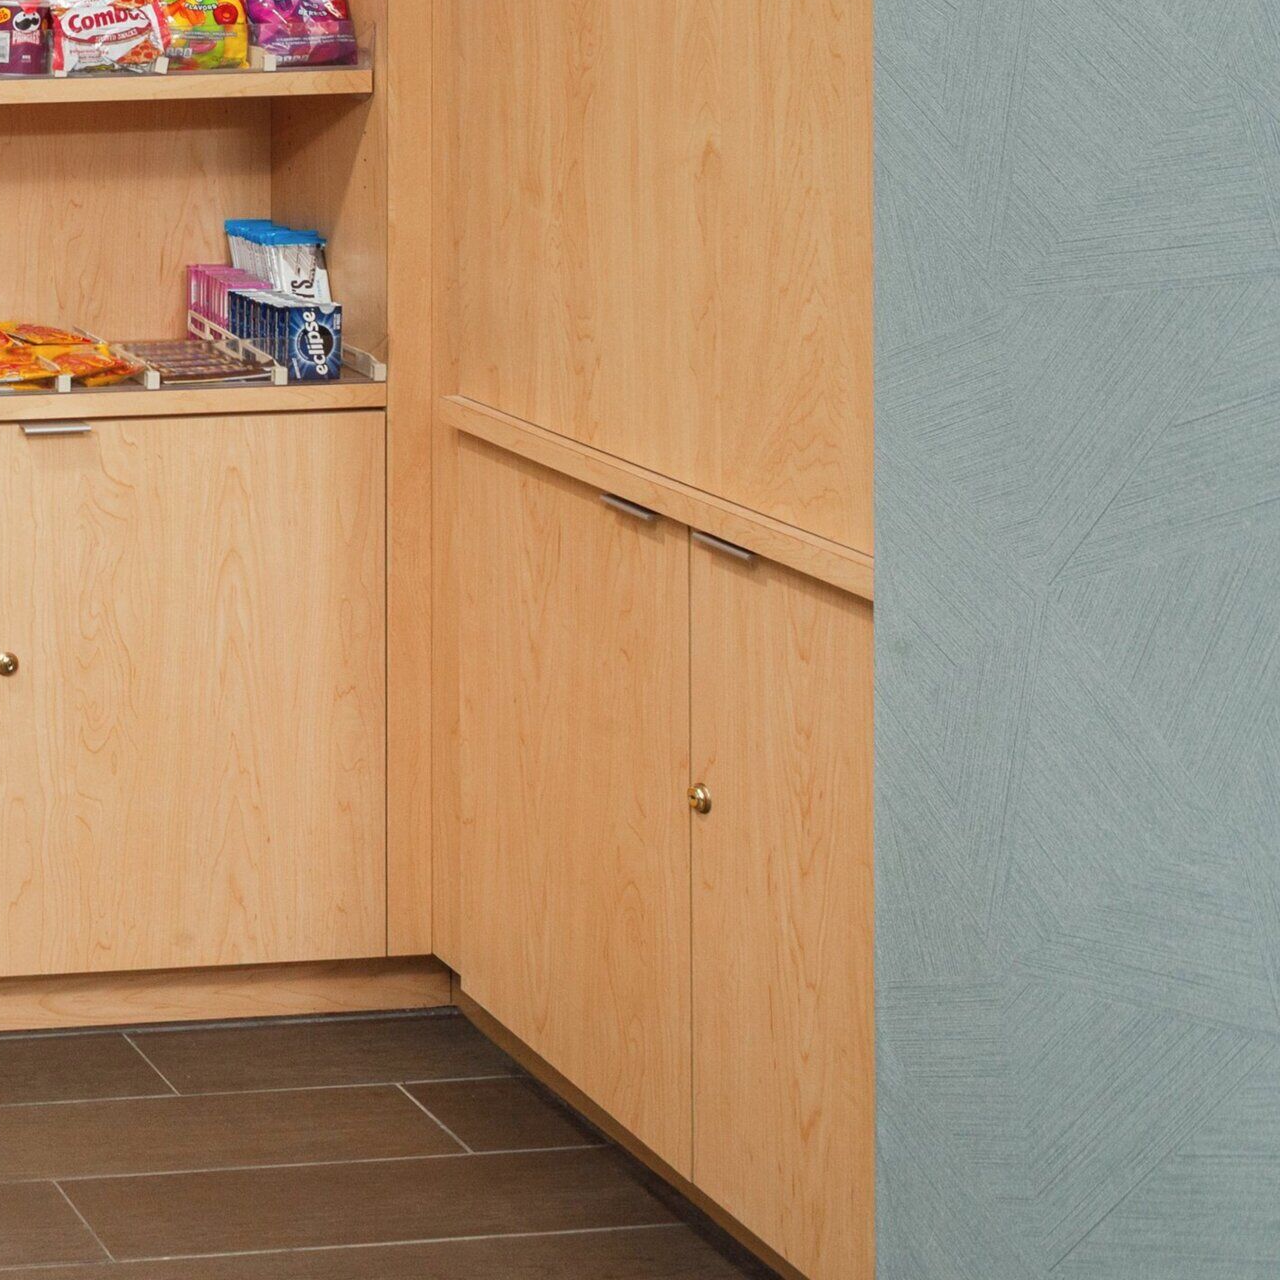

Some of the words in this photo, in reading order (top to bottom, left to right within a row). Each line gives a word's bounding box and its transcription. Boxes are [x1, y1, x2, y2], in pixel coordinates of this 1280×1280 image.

[184, 3, 218, 11] FLAVORS
[68, 8, 140, 33] Comb
[118, 29, 137, 39] SNACKS
[303, 311, 328, 375] eclipse
